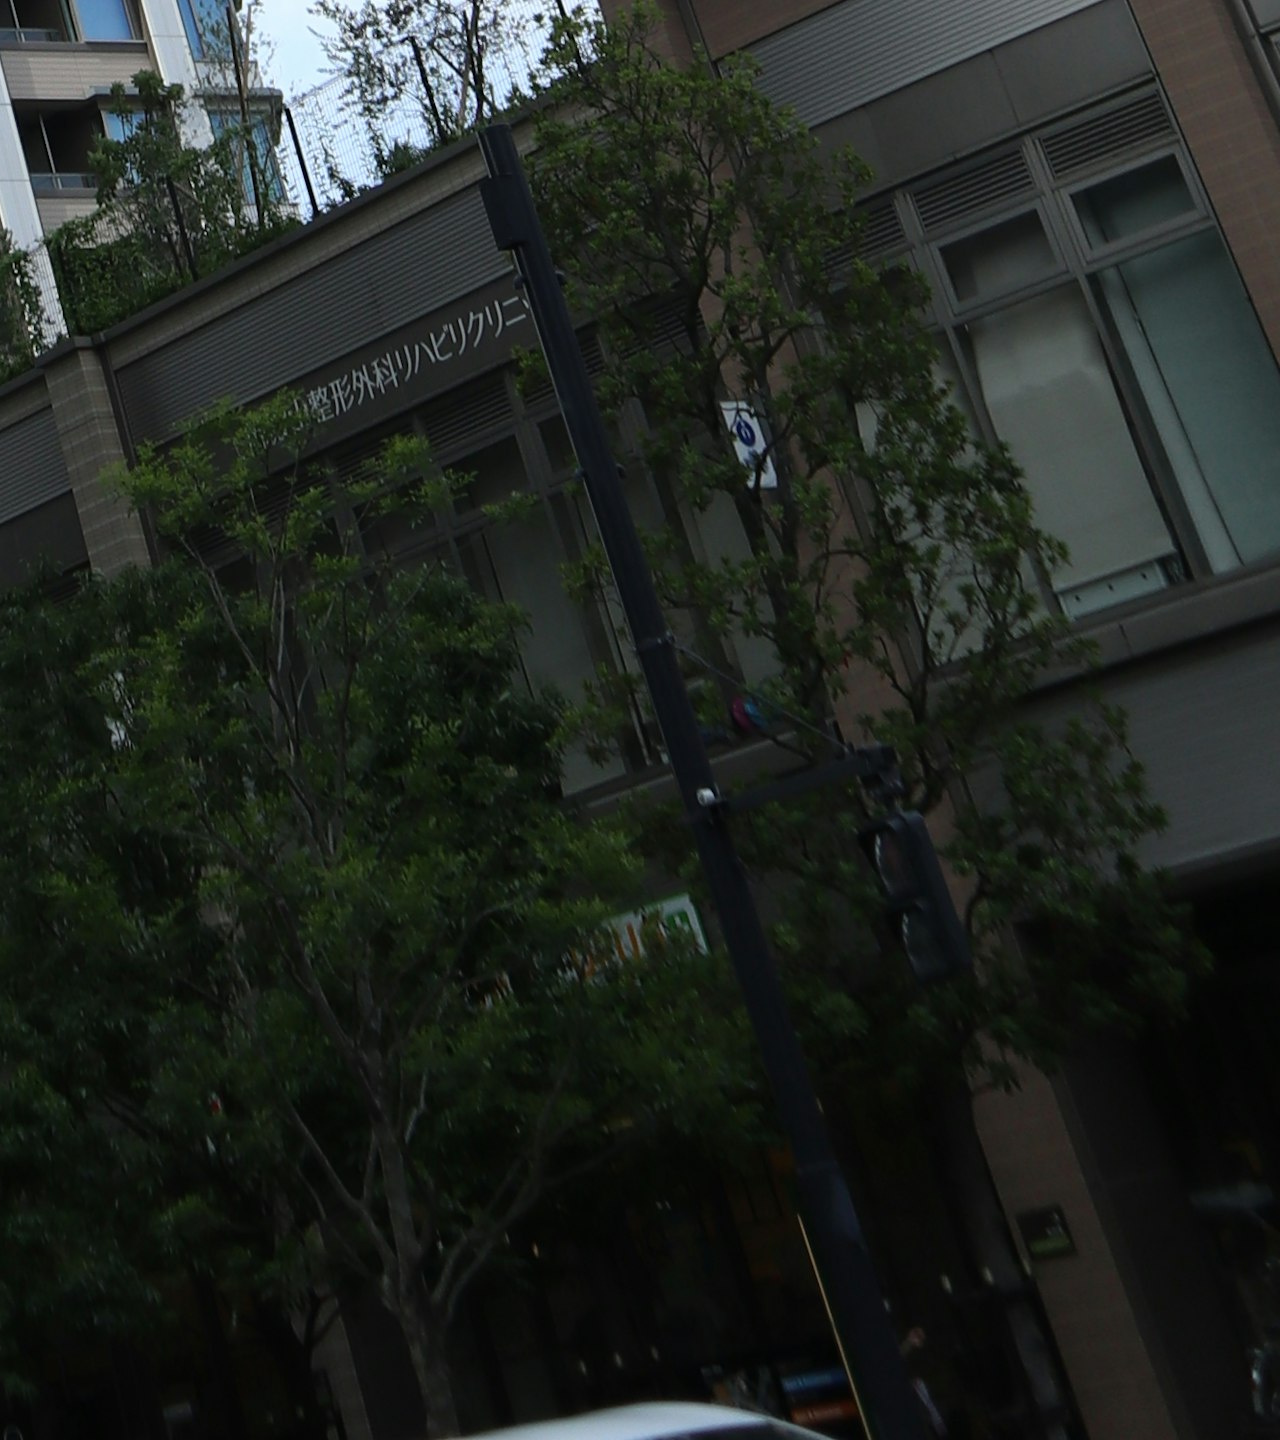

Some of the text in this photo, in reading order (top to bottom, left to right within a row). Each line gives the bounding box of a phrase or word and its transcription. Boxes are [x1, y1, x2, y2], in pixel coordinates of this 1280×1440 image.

[285, 296, 530, 425] 整形外科リハビリクリニ
